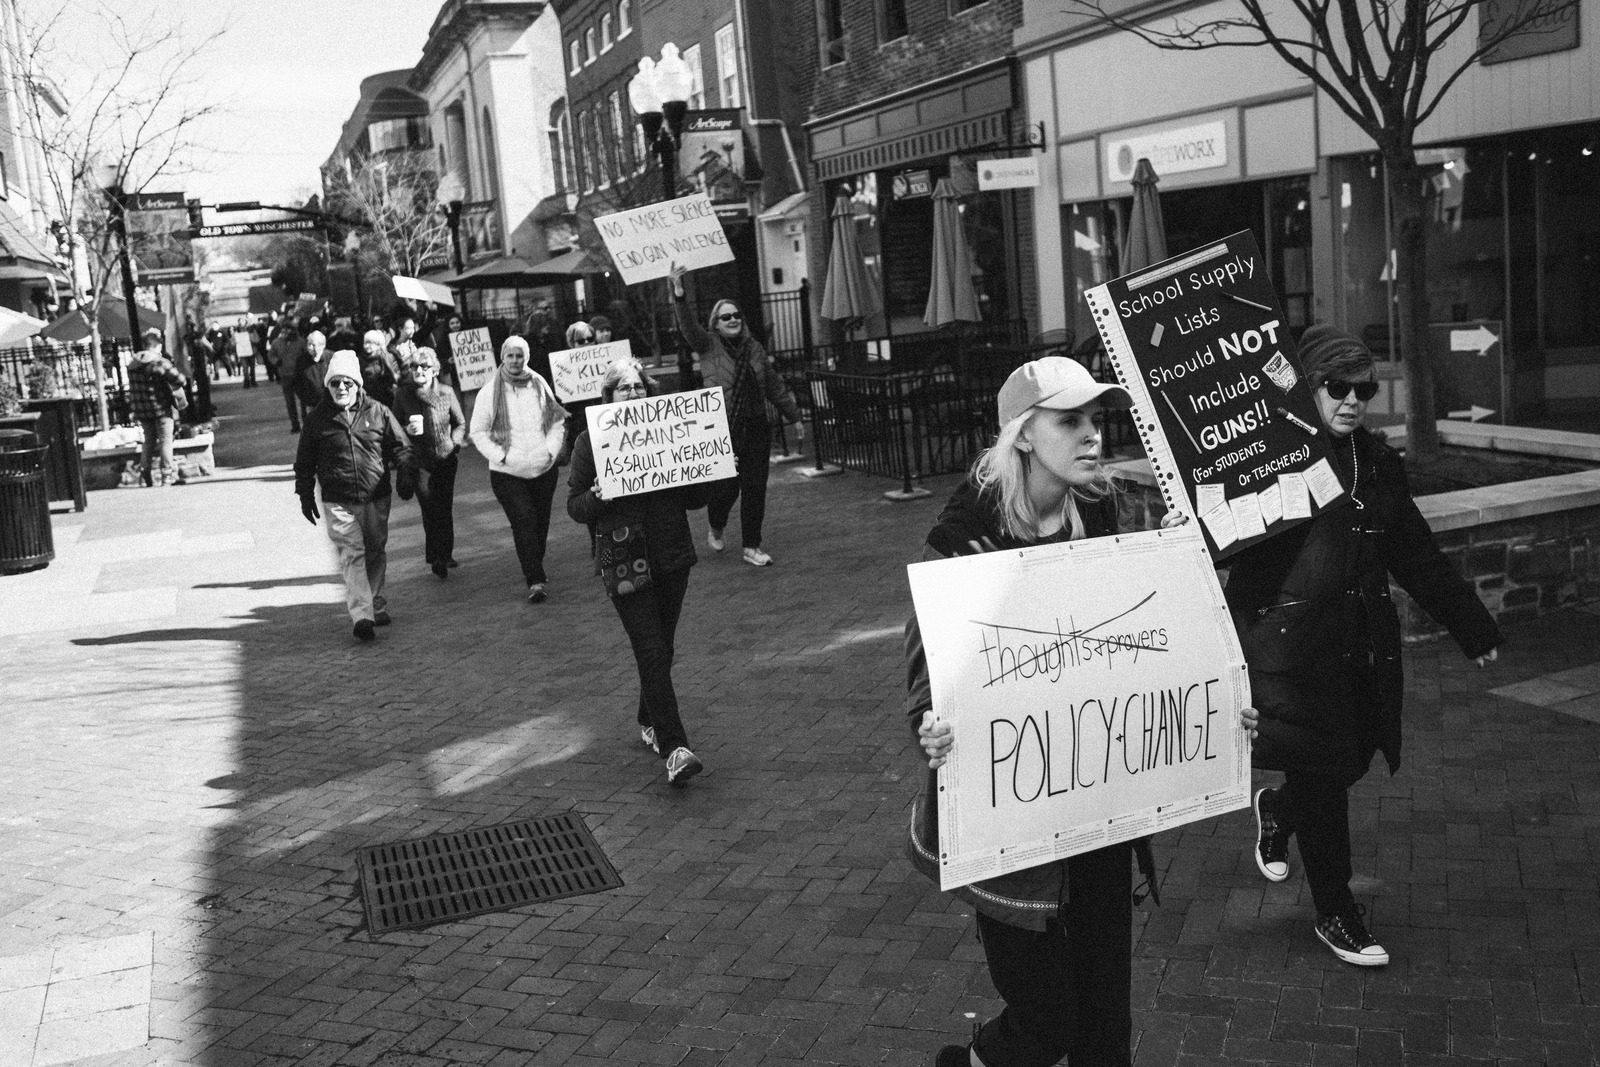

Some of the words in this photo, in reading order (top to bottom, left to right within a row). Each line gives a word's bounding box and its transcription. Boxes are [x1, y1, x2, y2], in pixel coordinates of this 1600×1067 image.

[199, 227, 222, 237] OLD
[222, 224, 252, 235] TOWN
[254, 219, 315, 231] WINCHESTER
[602, 220, 624, 239] NO
[629, 209, 672, 233] MORE
[616, 250, 644, 269] END
[643, 242, 669, 263] GUN
[670, 229, 728, 253] VIOLENCE
[1119, 278, 1184, 318] School
[1189, 255, 1254, 290] Supply
[1174, 307, 1220, 335] Lists
[453, 341, 493, 357] VIOLENCE
[456, 329, 481, 346] GUN
[1149, 345, 1216, 387] Should
[1218, 319, 1280, 360] NOT
[459, 357, 467, 367] IS
[569, 346, 611, 363] PROTECT
[578, 360, 612, 379] KID
[577, 380, 598, 394] NOT
[1189, 372, 1261, 414] Include
[597, 391, 721, 431] GRANDPARENTS
[1200, 399, 1271, 450] GUNS!!
[619, 420, 697, 451] AGAINST
[605, 450, 666, 477] ASSAULT
[671, 436, 731, 463] WEAPONS
[1192, 466, 1214, 483] (For
[1215, 440, 1267, 472] STUDENTS
[1238, 474, 1252, 486] Or
[1252, 444, 1310, 481] TEACHERS!)
[652, 468, 677, 487] ONE
[990, 697, 1117, 808] POLICY
[1123, 678, 1219, 775] CHANGE
